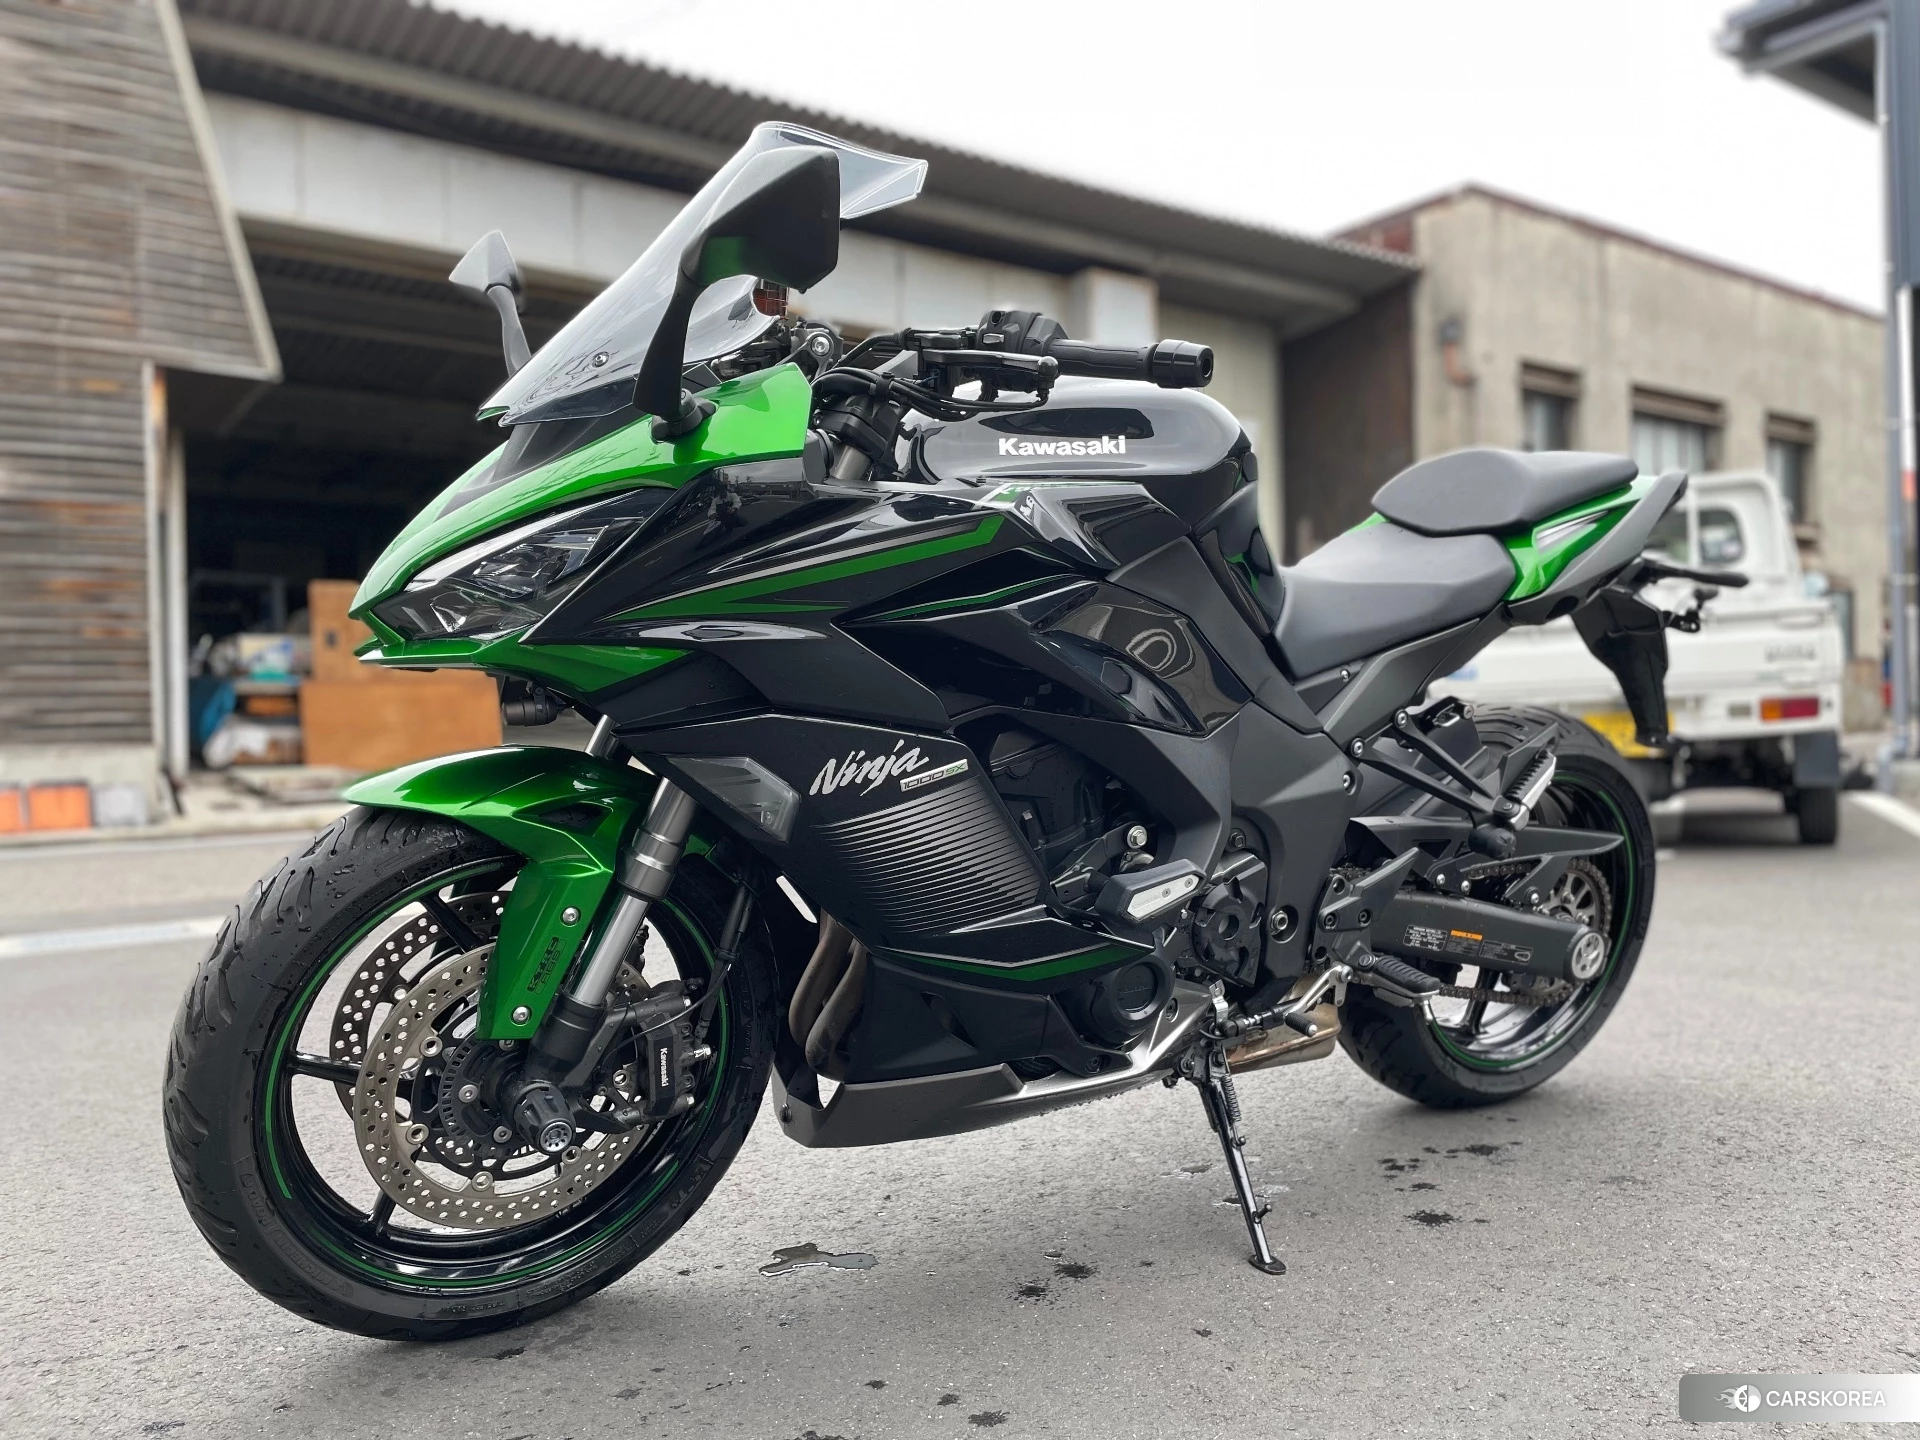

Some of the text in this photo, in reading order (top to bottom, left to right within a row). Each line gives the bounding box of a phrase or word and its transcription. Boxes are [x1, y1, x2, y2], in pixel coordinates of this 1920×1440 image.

[998, 435, 1126, 456] Kawasaki
[809, 739, 929, 796] Ninja
[902, 762, 966, 790] 1000SX
[660, 1047, 669, 1087] Kawasaki
